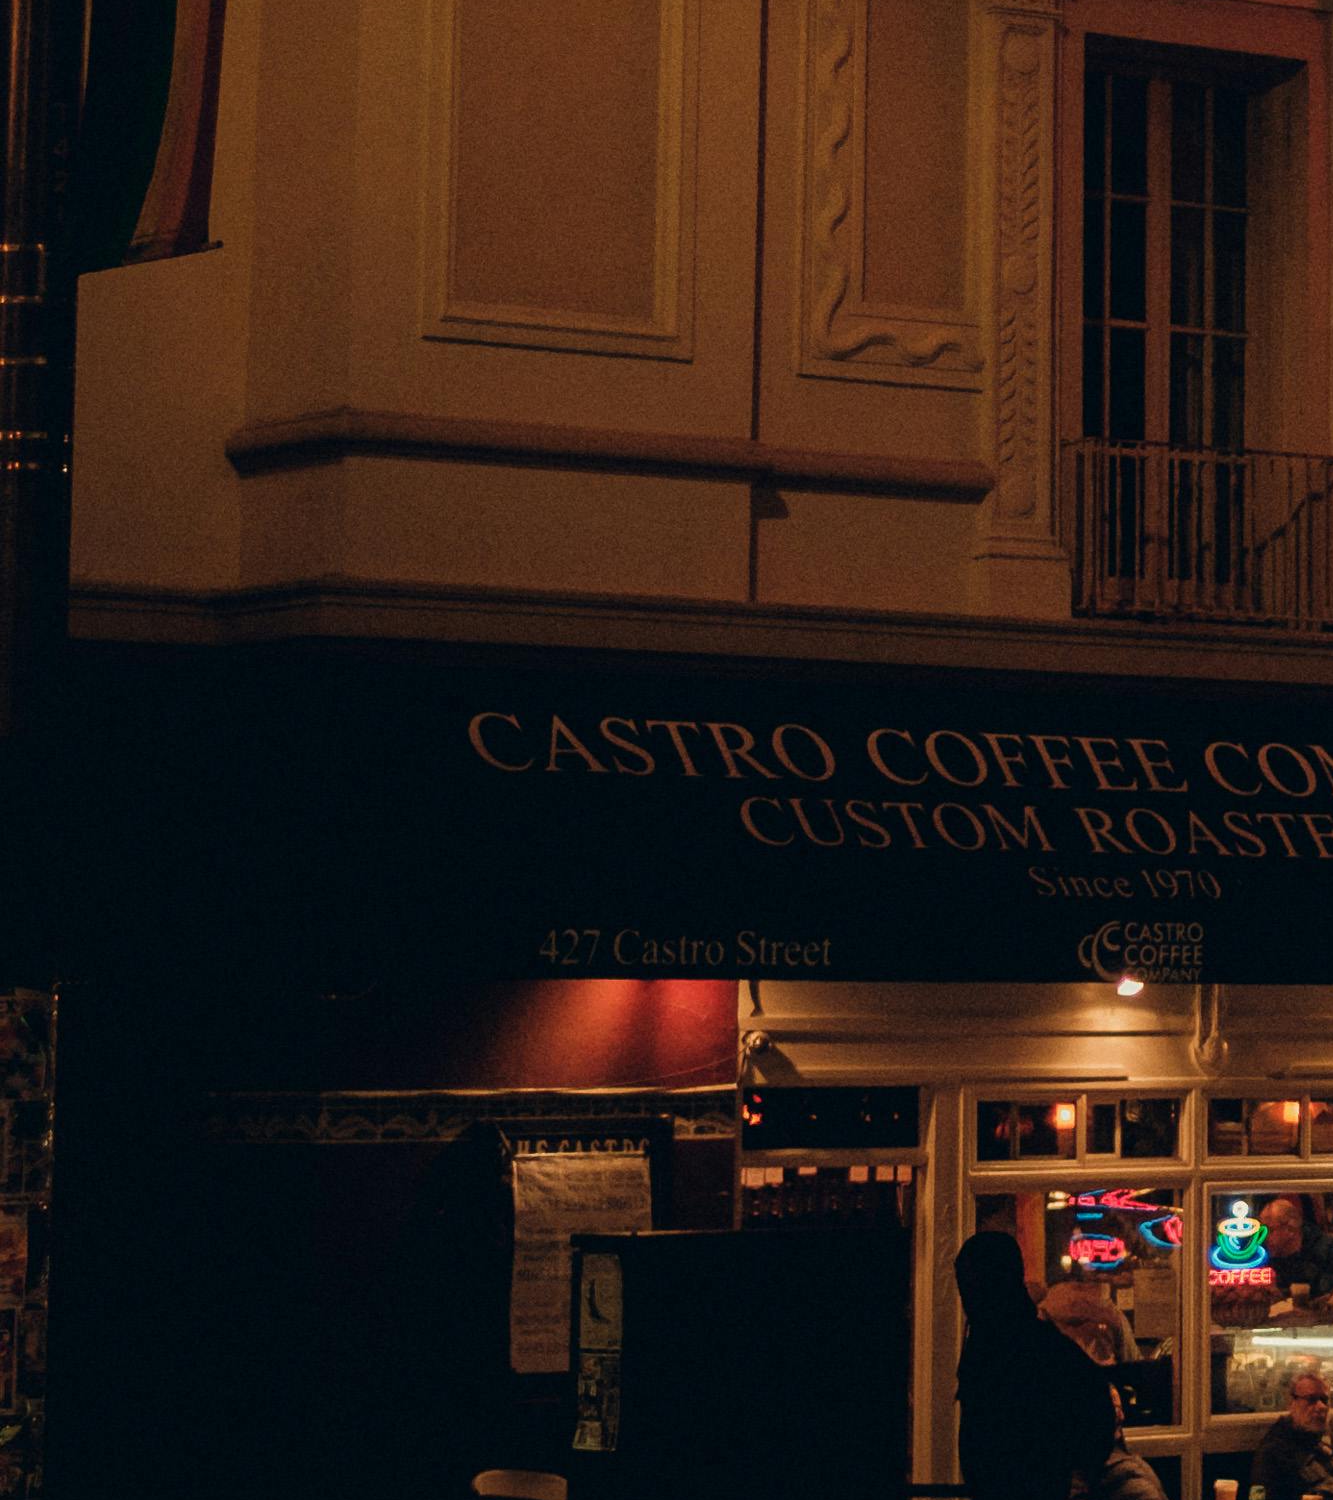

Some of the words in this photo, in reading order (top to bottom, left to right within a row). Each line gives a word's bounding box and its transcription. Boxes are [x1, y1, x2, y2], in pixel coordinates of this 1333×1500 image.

[466, 710, 838, 783] CASTRO
[865, 727, 1189, 793] COFFEE
[739, 796, 1056, 853] CUSTOM
[1027, 865, 1132, 900] Since
[1139, 868, 1222, 901] 1970
[537, 928, 601, 966] 427
[612, 929, 725, 967] Castro
[736, 929, 832, 968] Street
[1124, 921, 1205, 942] CASTRO
[1124, 944, 1204, 966] COFFEE
[1209, 1267, 1273, 1286] COFFEE
